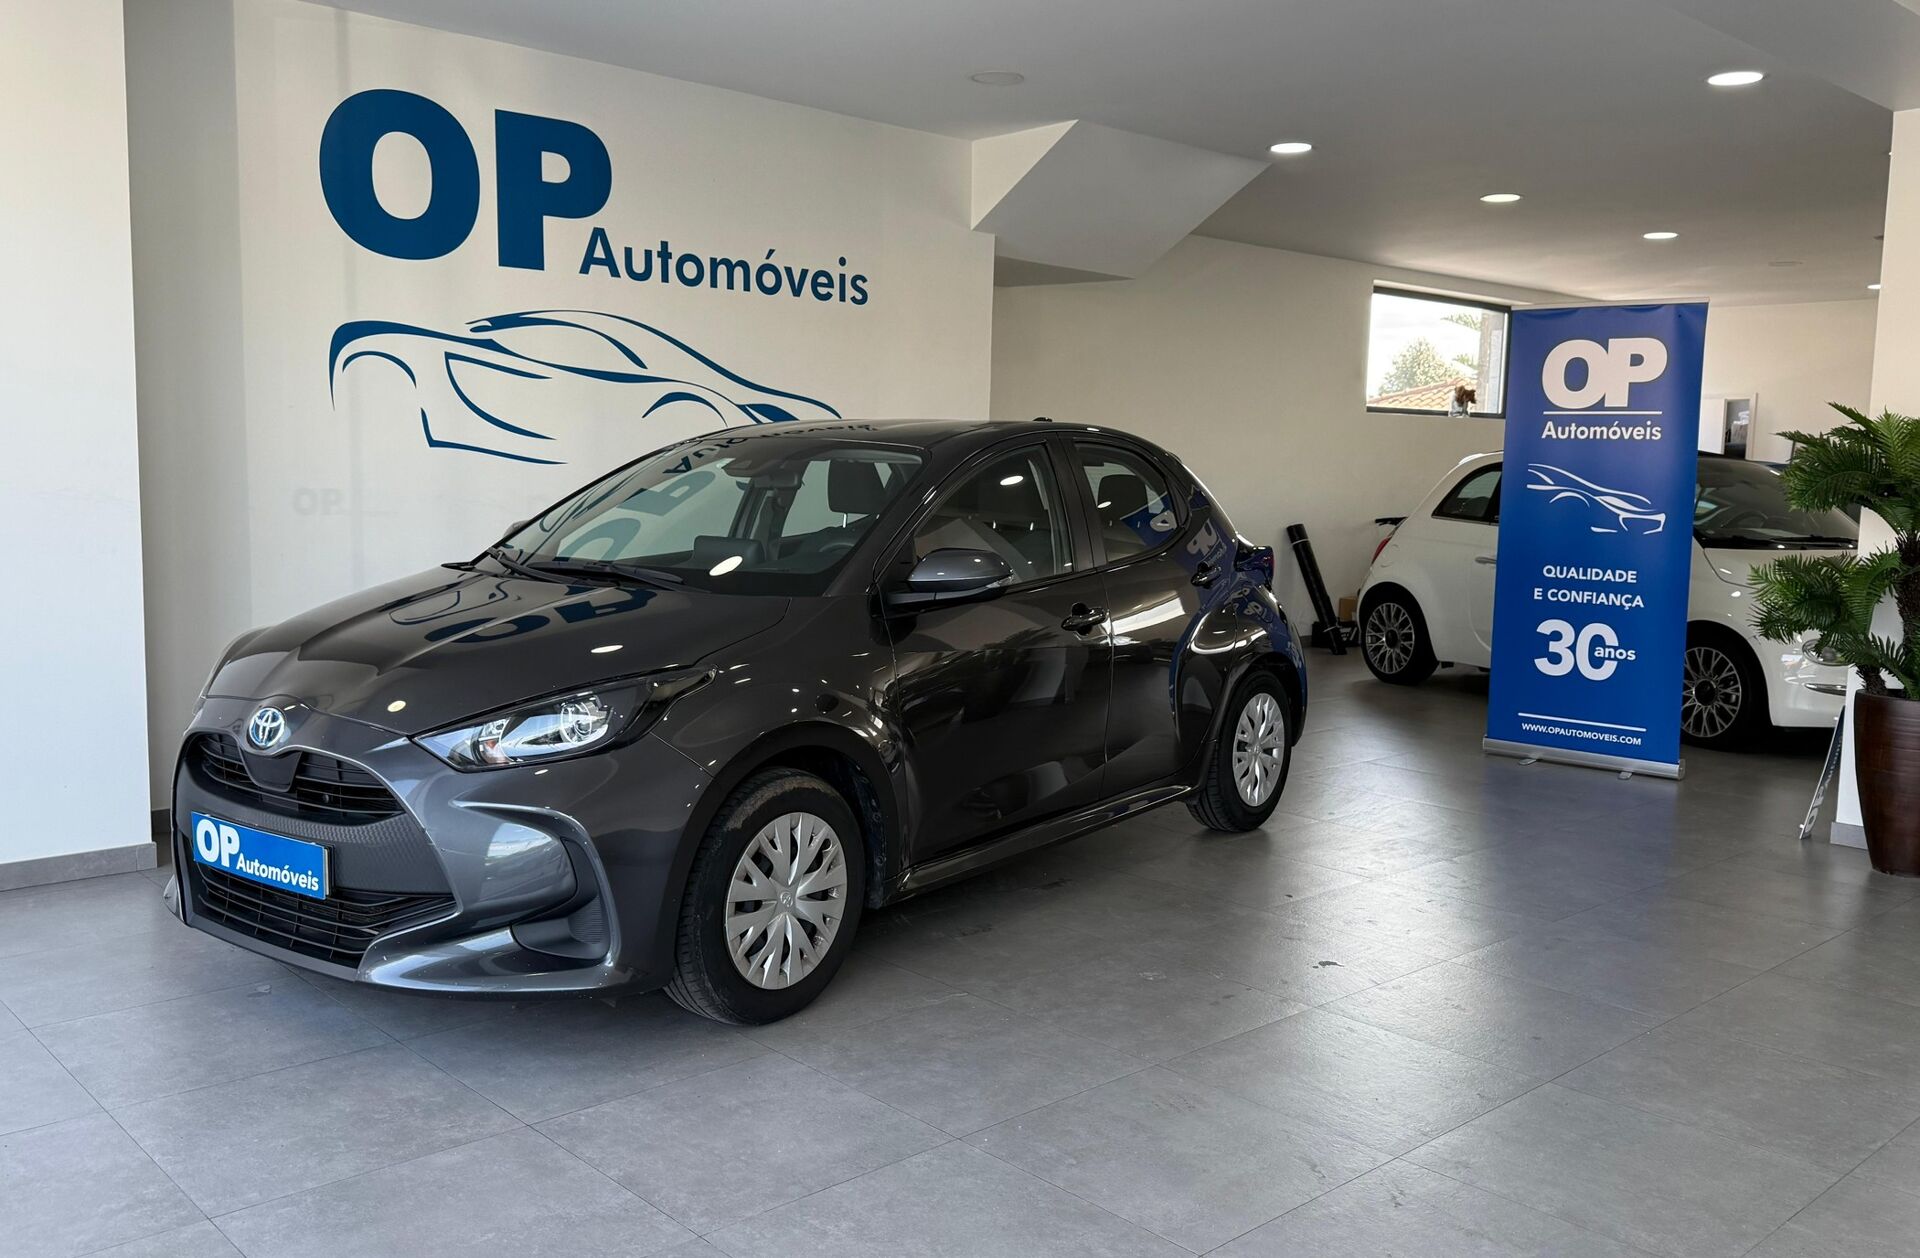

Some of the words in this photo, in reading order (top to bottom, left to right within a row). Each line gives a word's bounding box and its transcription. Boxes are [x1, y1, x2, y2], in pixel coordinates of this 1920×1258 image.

[319, 89, 612, 271] OP
[579, 227, 869, 306] Automóveis
[1541, 337, 1668, 410] OP
[1541, 420, 1662, 441] Automóveis
[1543, 565, 1637, 583] QUALIDADE
[1534, 588, 1543, 600] E
[1548, 588, 1644, 610] CONFIANÇA
[1534, 619, 1619, 681] 30
[1594, 646, 1636, 661] anos
[1521, 722, 1642, 746] WWW.OPAUTOMOVEIS.COM
[196, 818, 240, 868] OP
[236, 852, 320, 891] Automóveis
